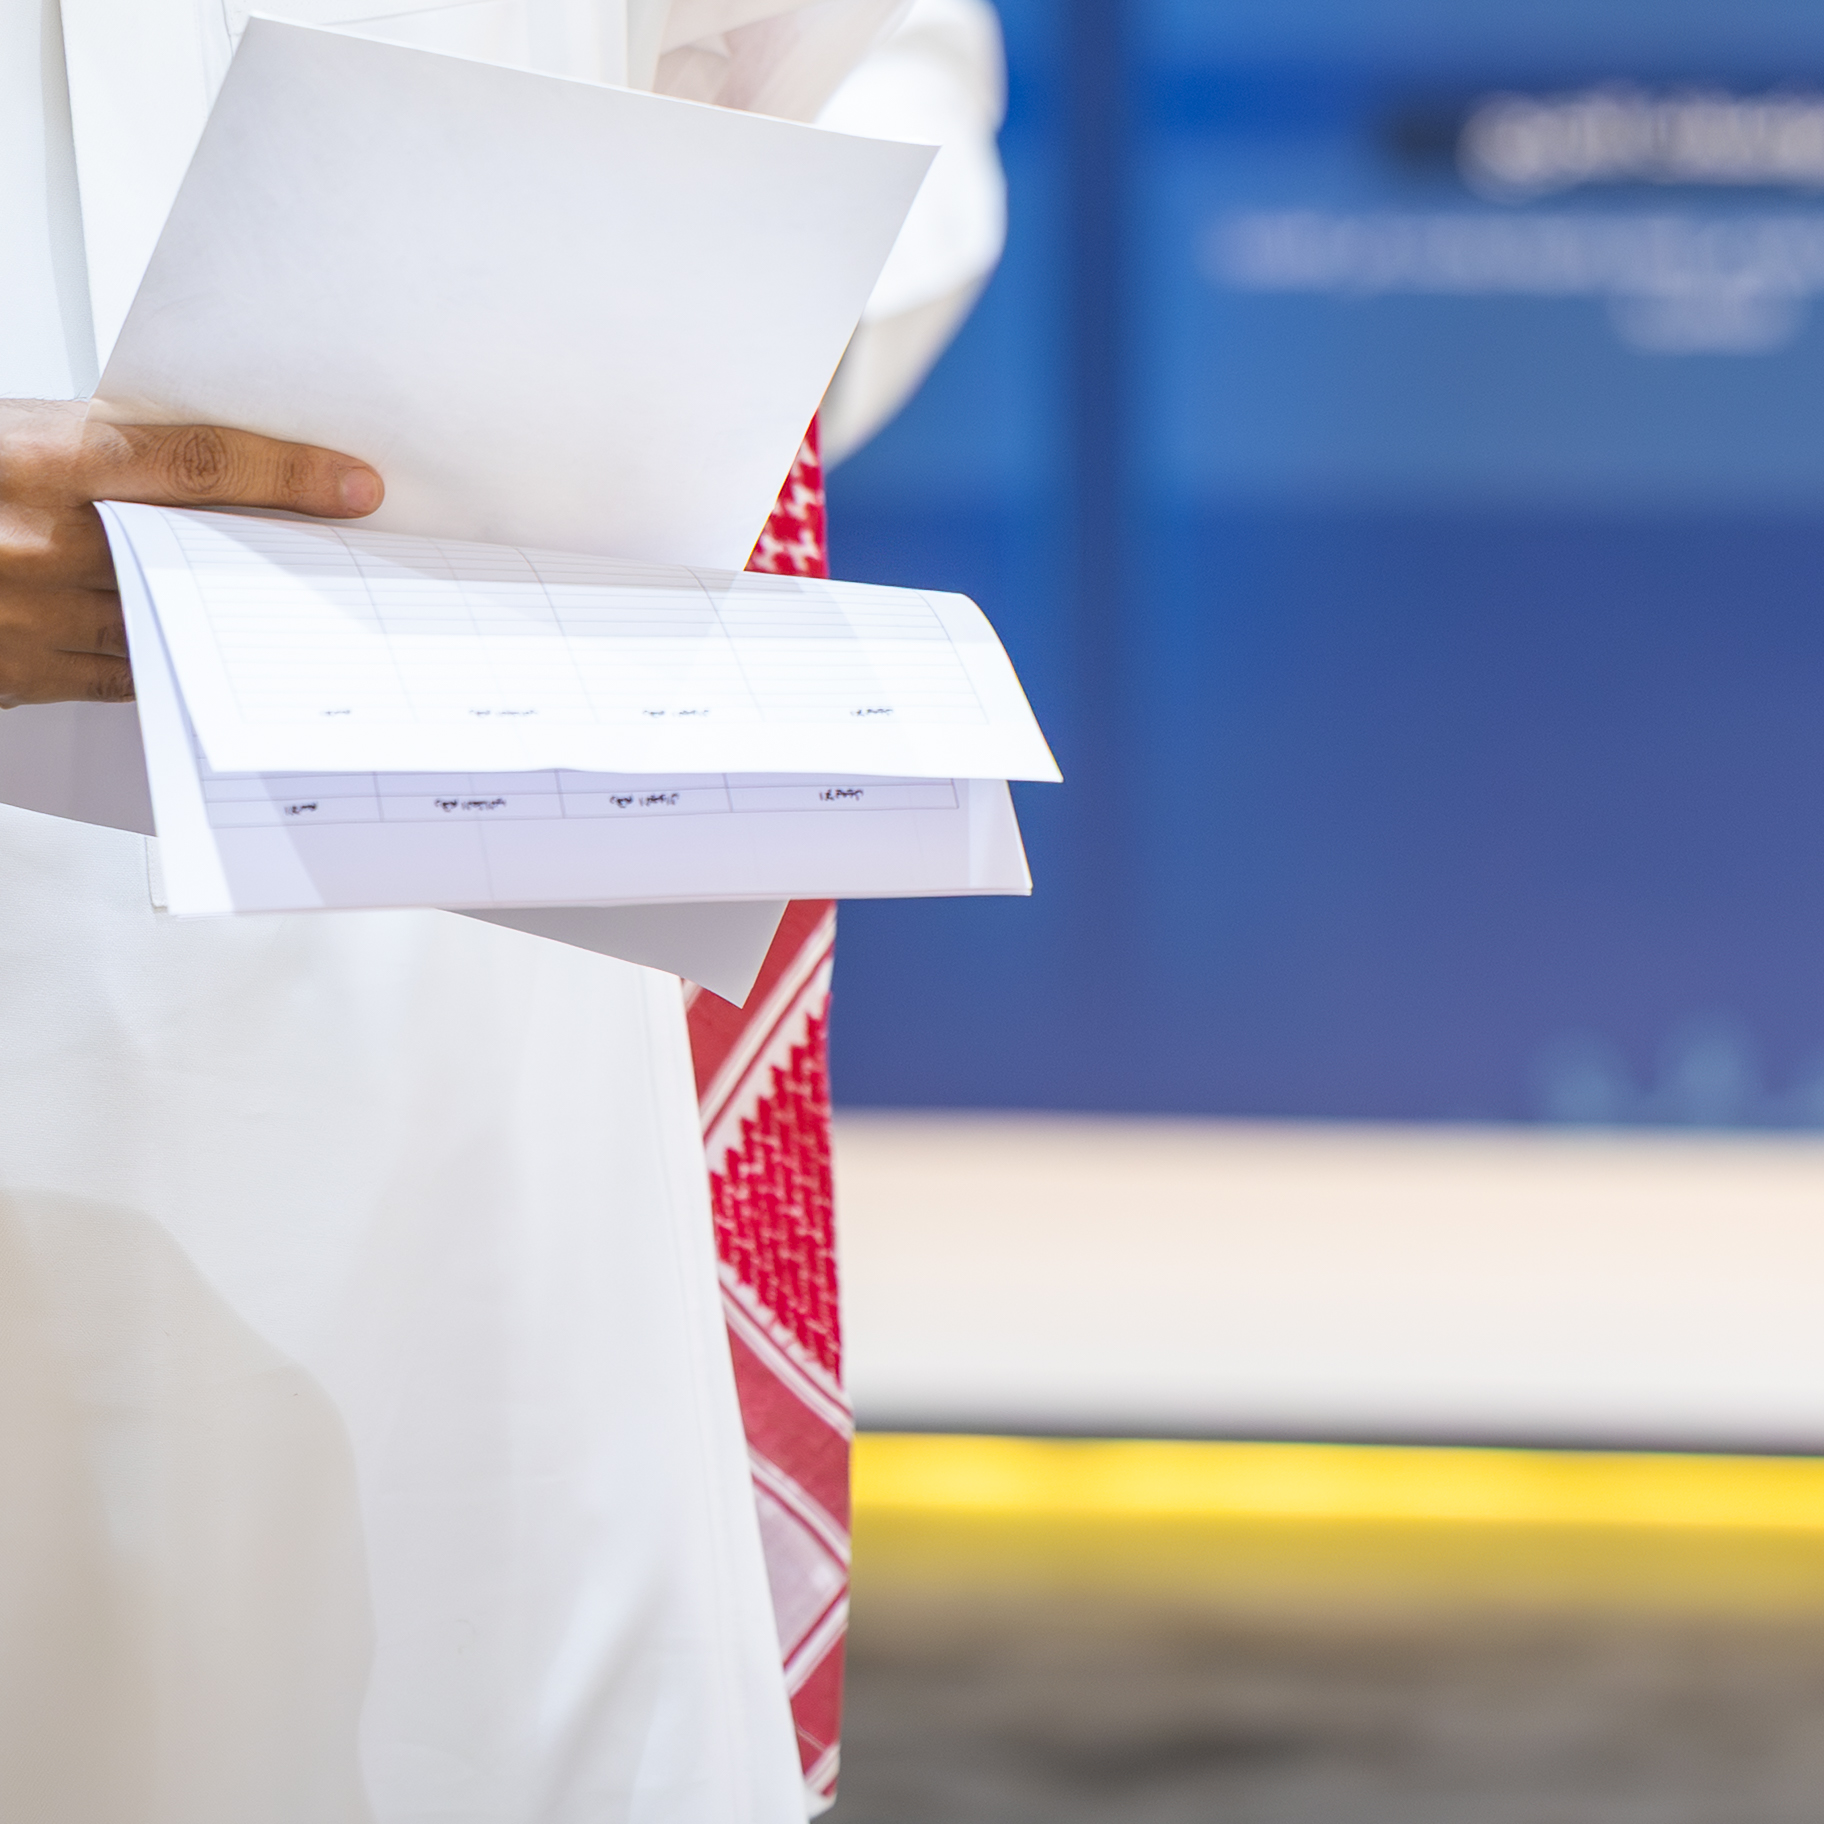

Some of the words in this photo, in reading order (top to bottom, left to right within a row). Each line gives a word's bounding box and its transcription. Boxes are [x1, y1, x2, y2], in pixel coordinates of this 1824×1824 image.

[433, 798, 458, 813] رقم
[609, 795, 633, 810] رقم
[638, 793, 680, 808] الجوال
